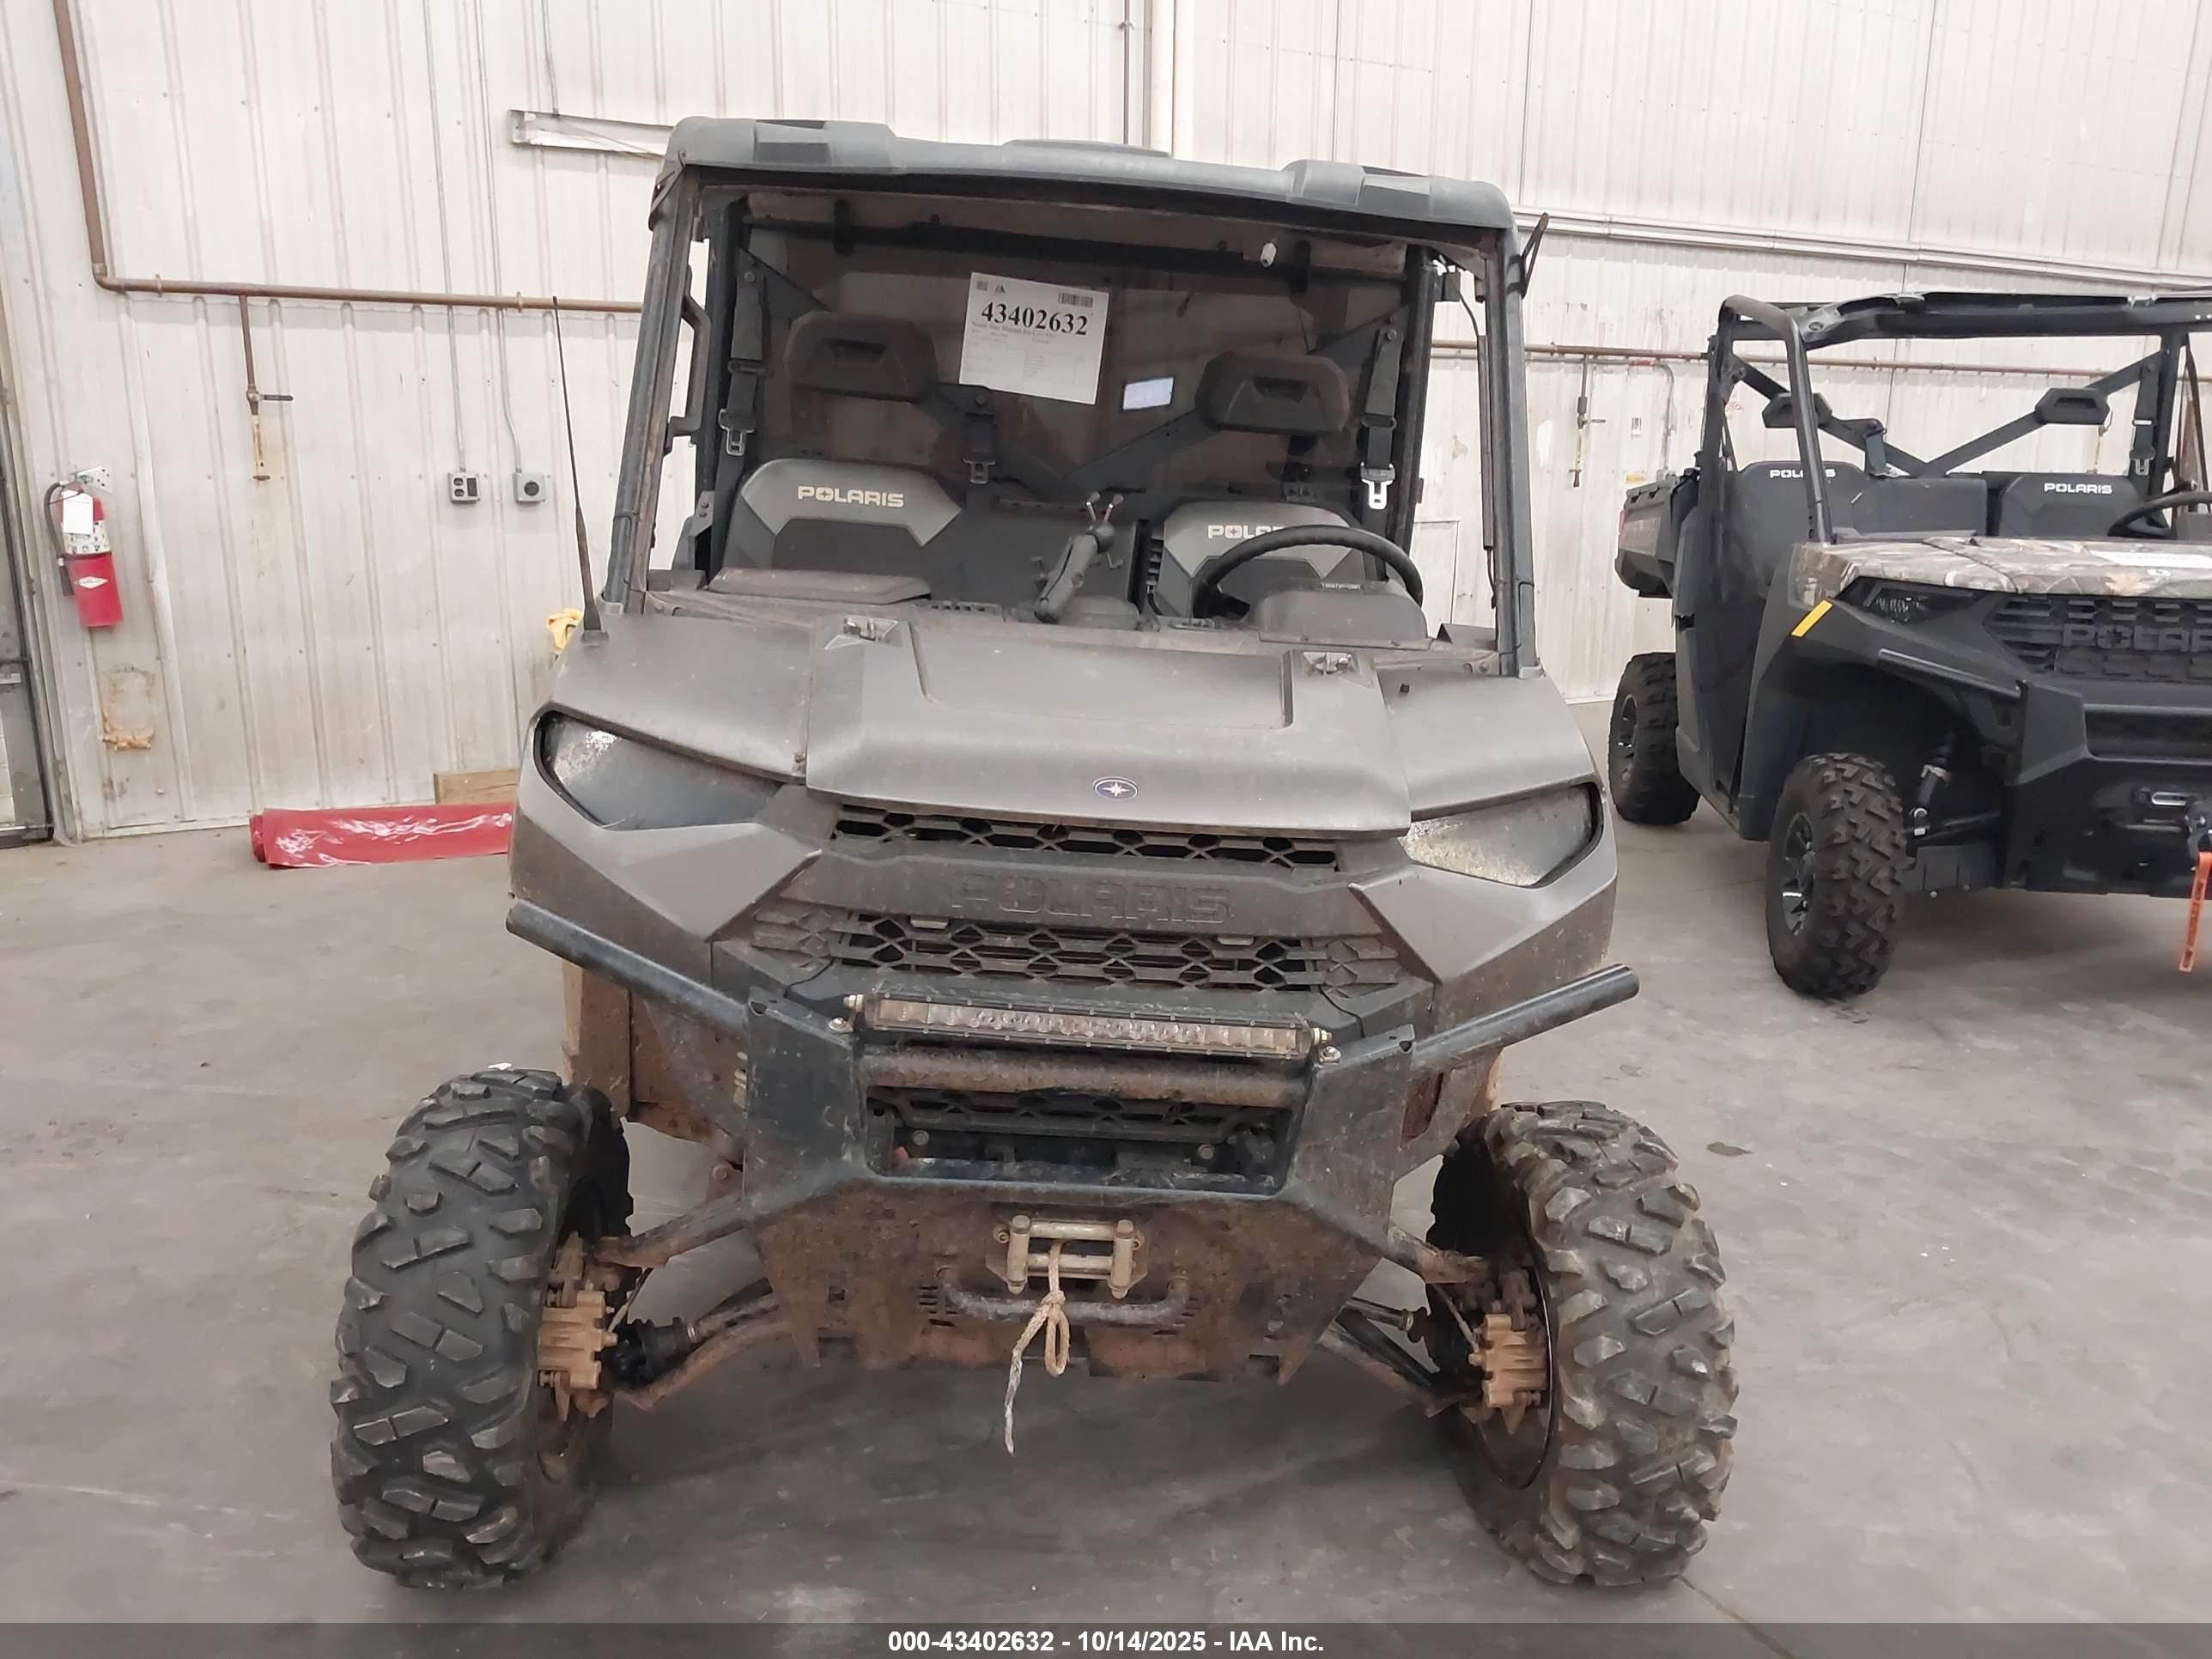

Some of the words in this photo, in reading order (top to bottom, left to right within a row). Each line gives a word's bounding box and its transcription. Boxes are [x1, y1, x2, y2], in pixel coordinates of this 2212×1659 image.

[981, 302, 1088, 336] 43402632
[1770, 469, 1836, 478] POLS
[798, 486, 904, 507] POLARIS
[2044, 483, 2112, 495] POLARIS
[1207, 525, 1285, 539] POLA
[948, 873, 1228, 924] POLARIS
